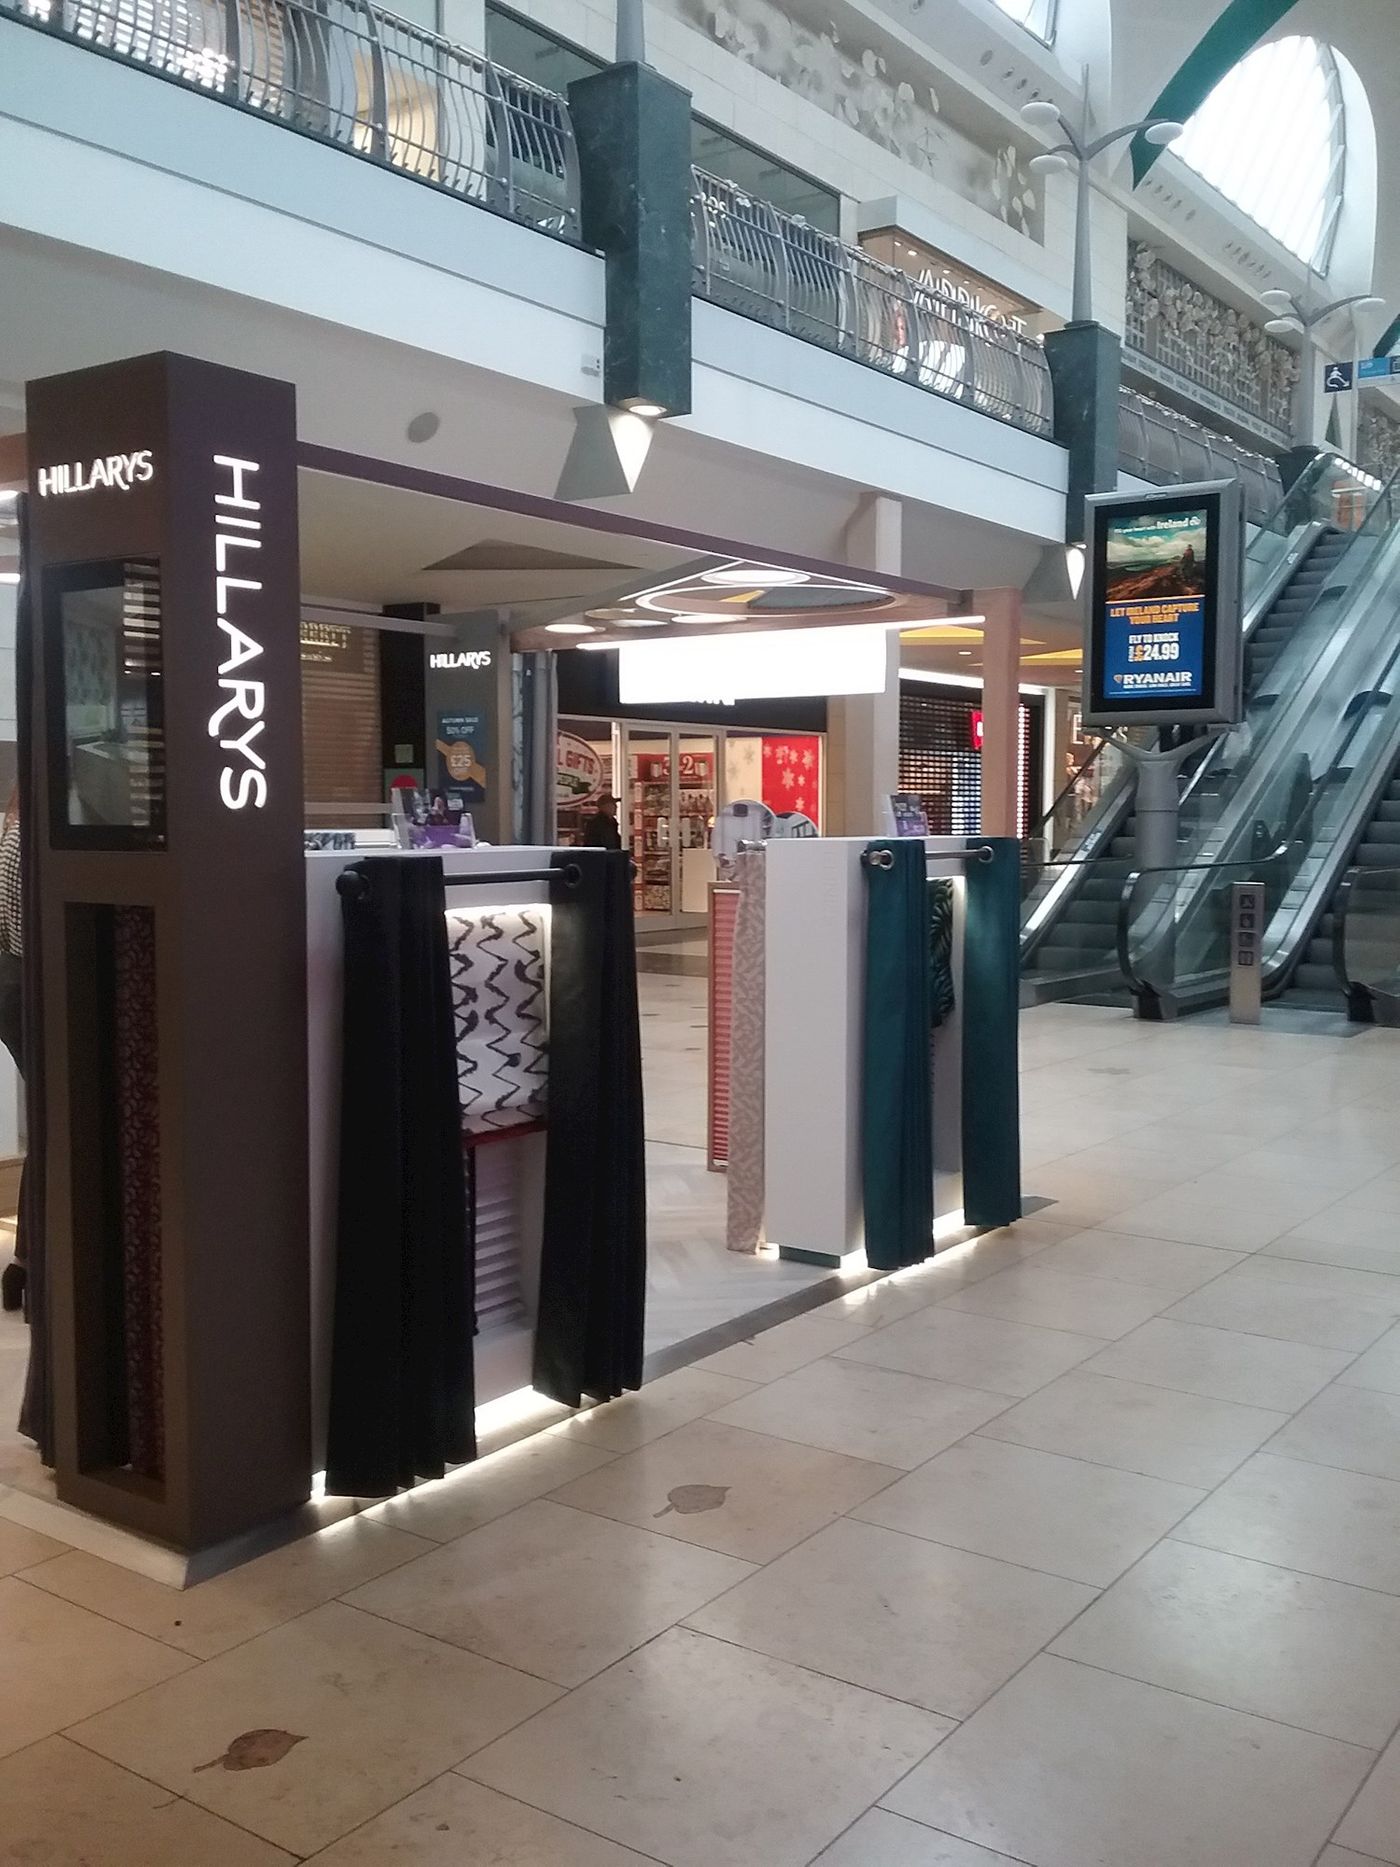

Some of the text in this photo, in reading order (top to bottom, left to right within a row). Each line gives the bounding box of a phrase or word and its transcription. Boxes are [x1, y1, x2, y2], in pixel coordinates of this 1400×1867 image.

[37, 449, 154, 497] HILLARYS
[208, 454, 268, 811] HILLARYS
[430, 651, 491, 670] HILLARYS
[1135, 642, 1179, 661] £24.99
[1123, 671, 1192, 684] RYANAIR
[682, 755, 694, 775] 2
